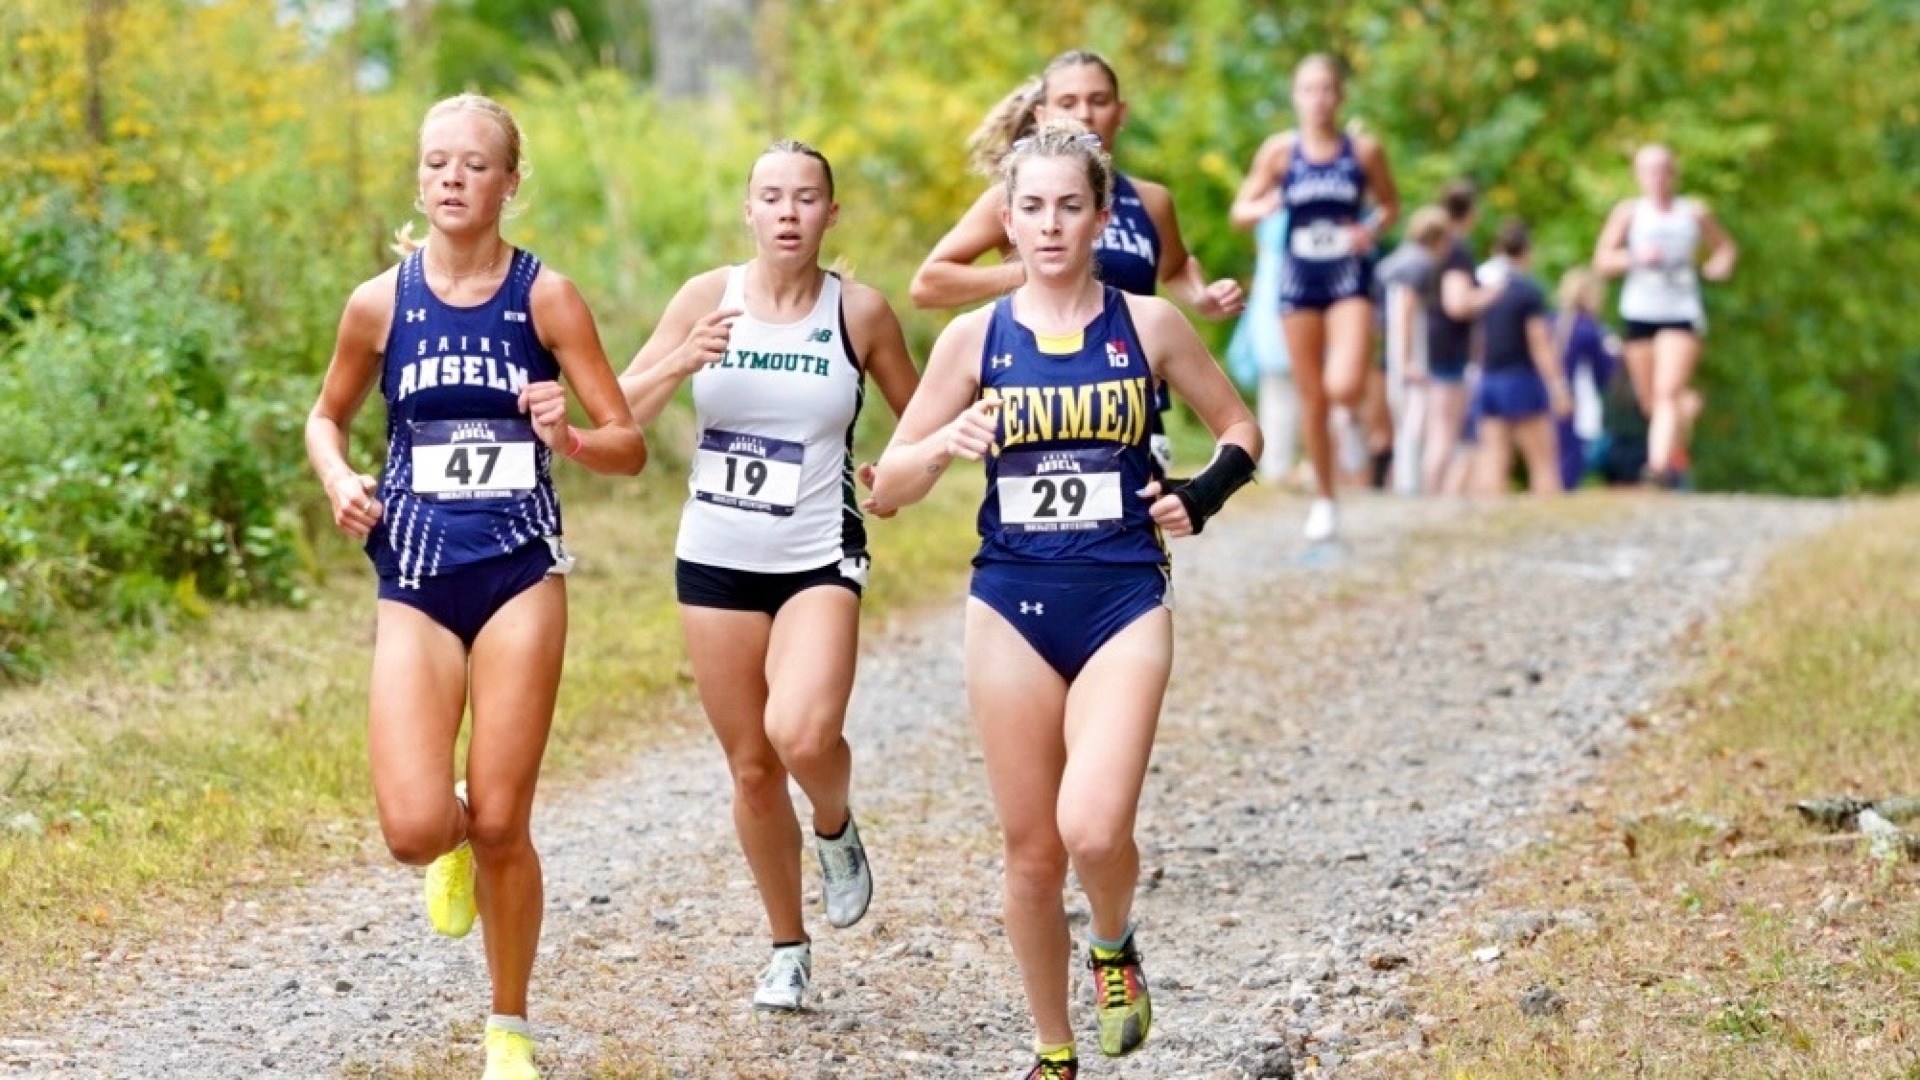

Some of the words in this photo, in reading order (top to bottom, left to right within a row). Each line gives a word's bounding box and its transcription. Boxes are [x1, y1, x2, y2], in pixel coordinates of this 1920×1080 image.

[417, 336, 511, 356] SAINT
[710, 350, 830, 376] LYMOUTH
[398, 355, 529, 401] ANSELM
[445, 446, 502, 485] 47
[725, 456, 768, 496] 19
[1032, 477, 1087, 517] 29
